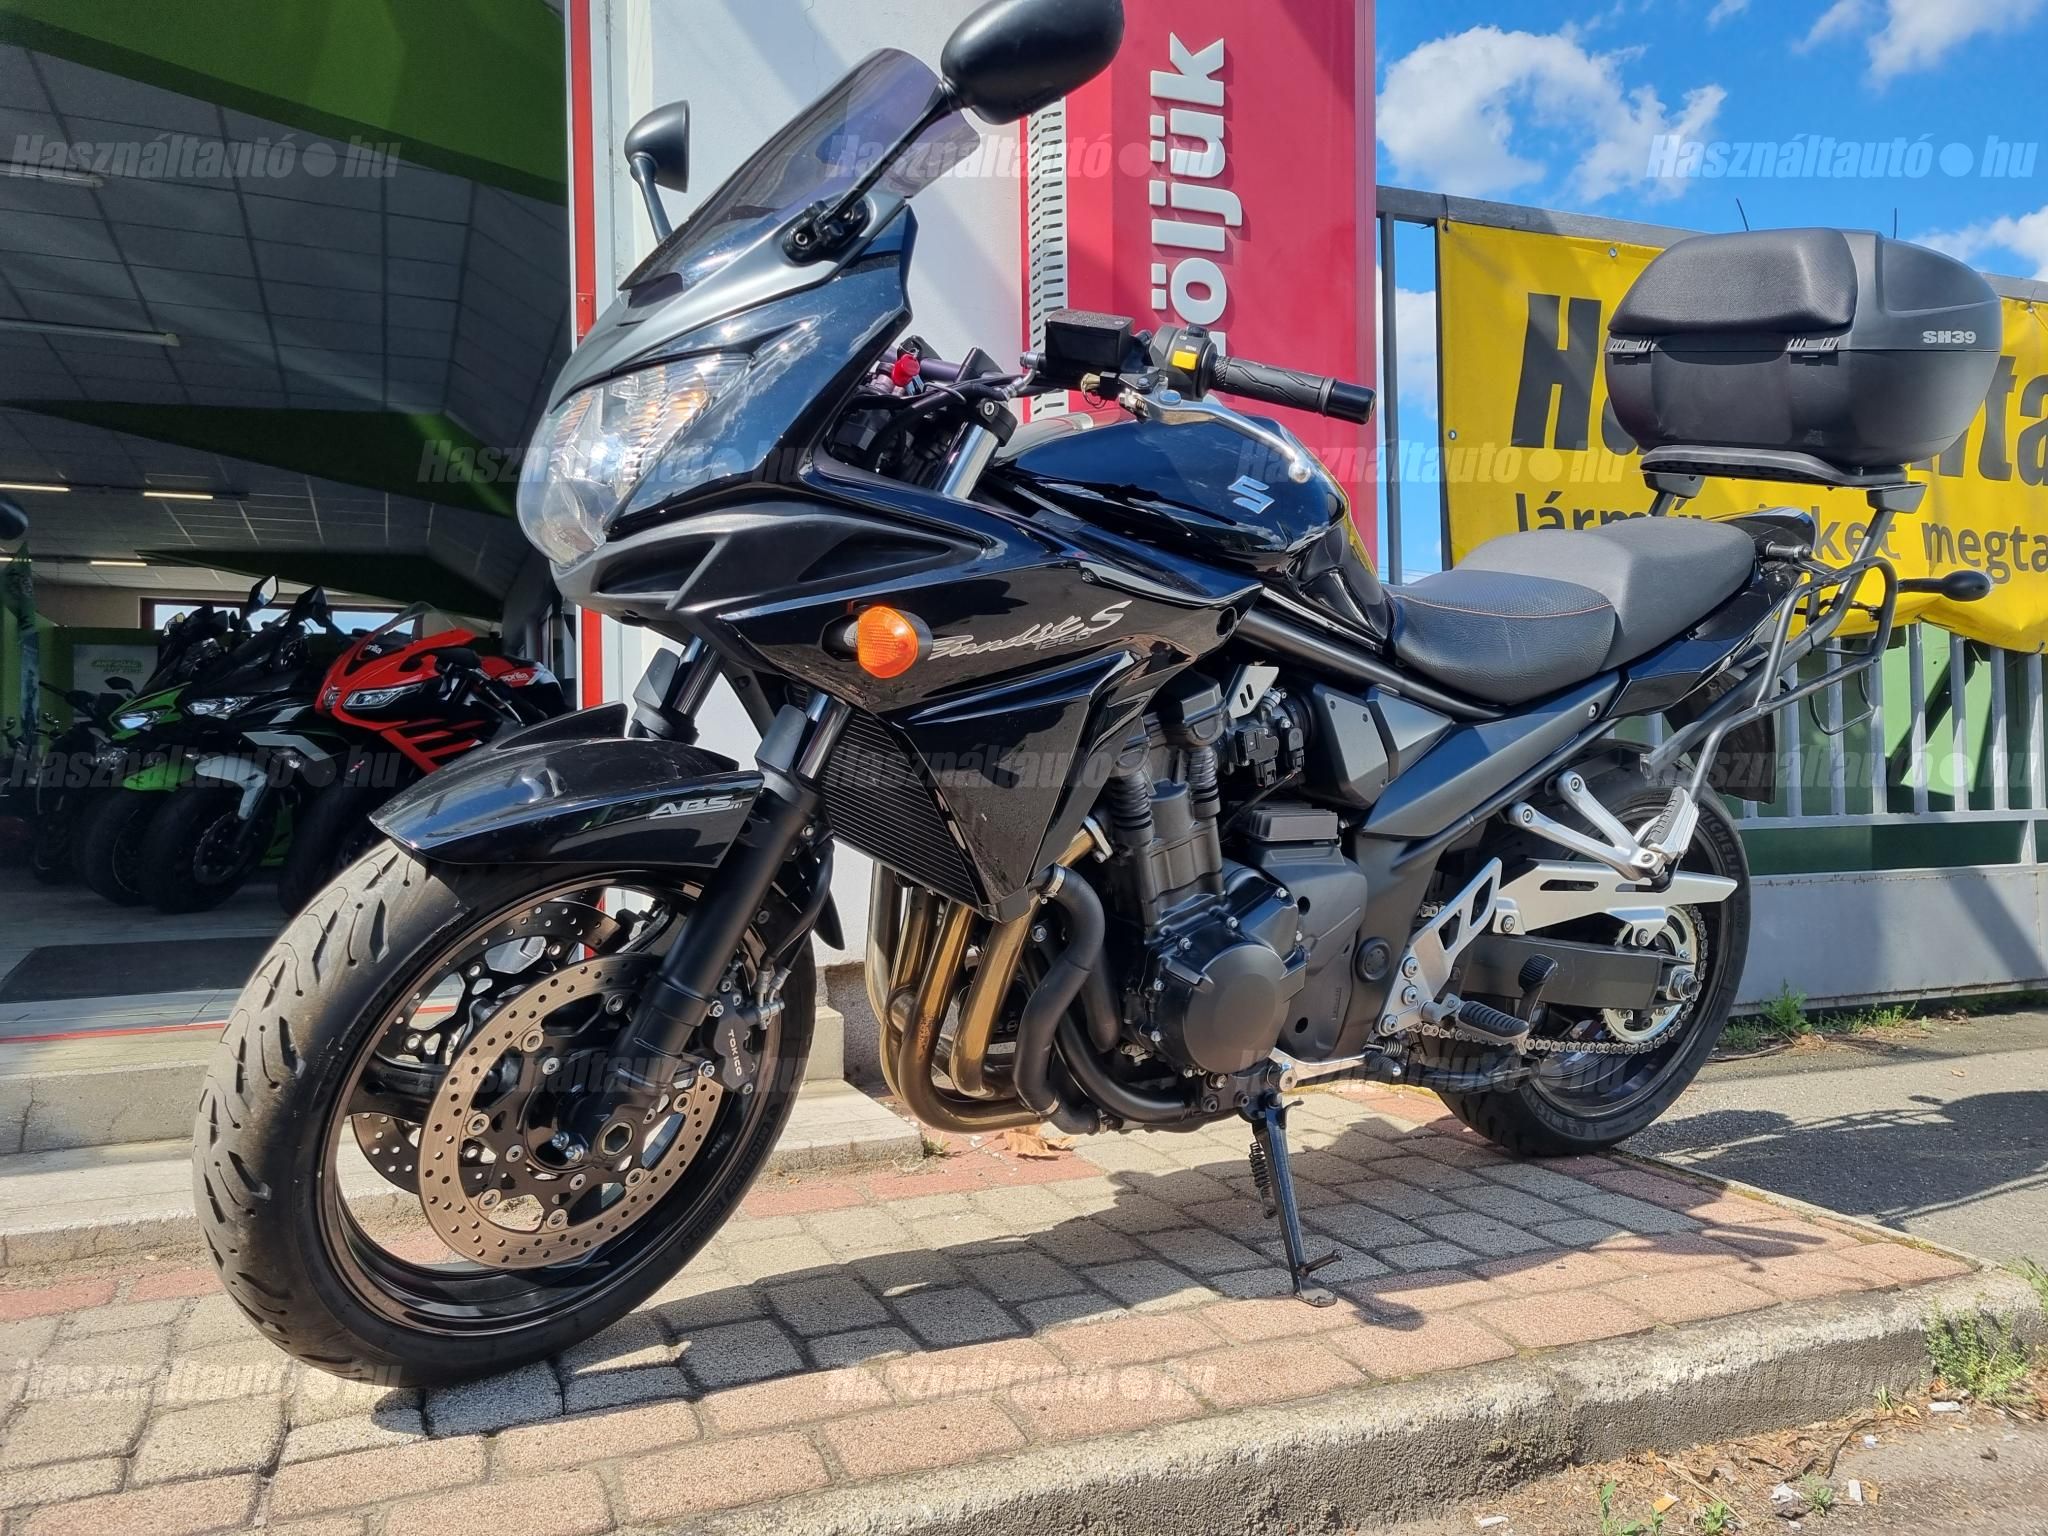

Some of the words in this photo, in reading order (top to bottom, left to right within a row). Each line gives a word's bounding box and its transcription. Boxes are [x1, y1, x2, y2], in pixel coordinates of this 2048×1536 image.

[1149, 31, 1243, 357] öljük
[1922, 330, 1977, 344] SH39
[649, 795, 734, 816] ABS
[727, 1028, 743, 1077] TOKICO
